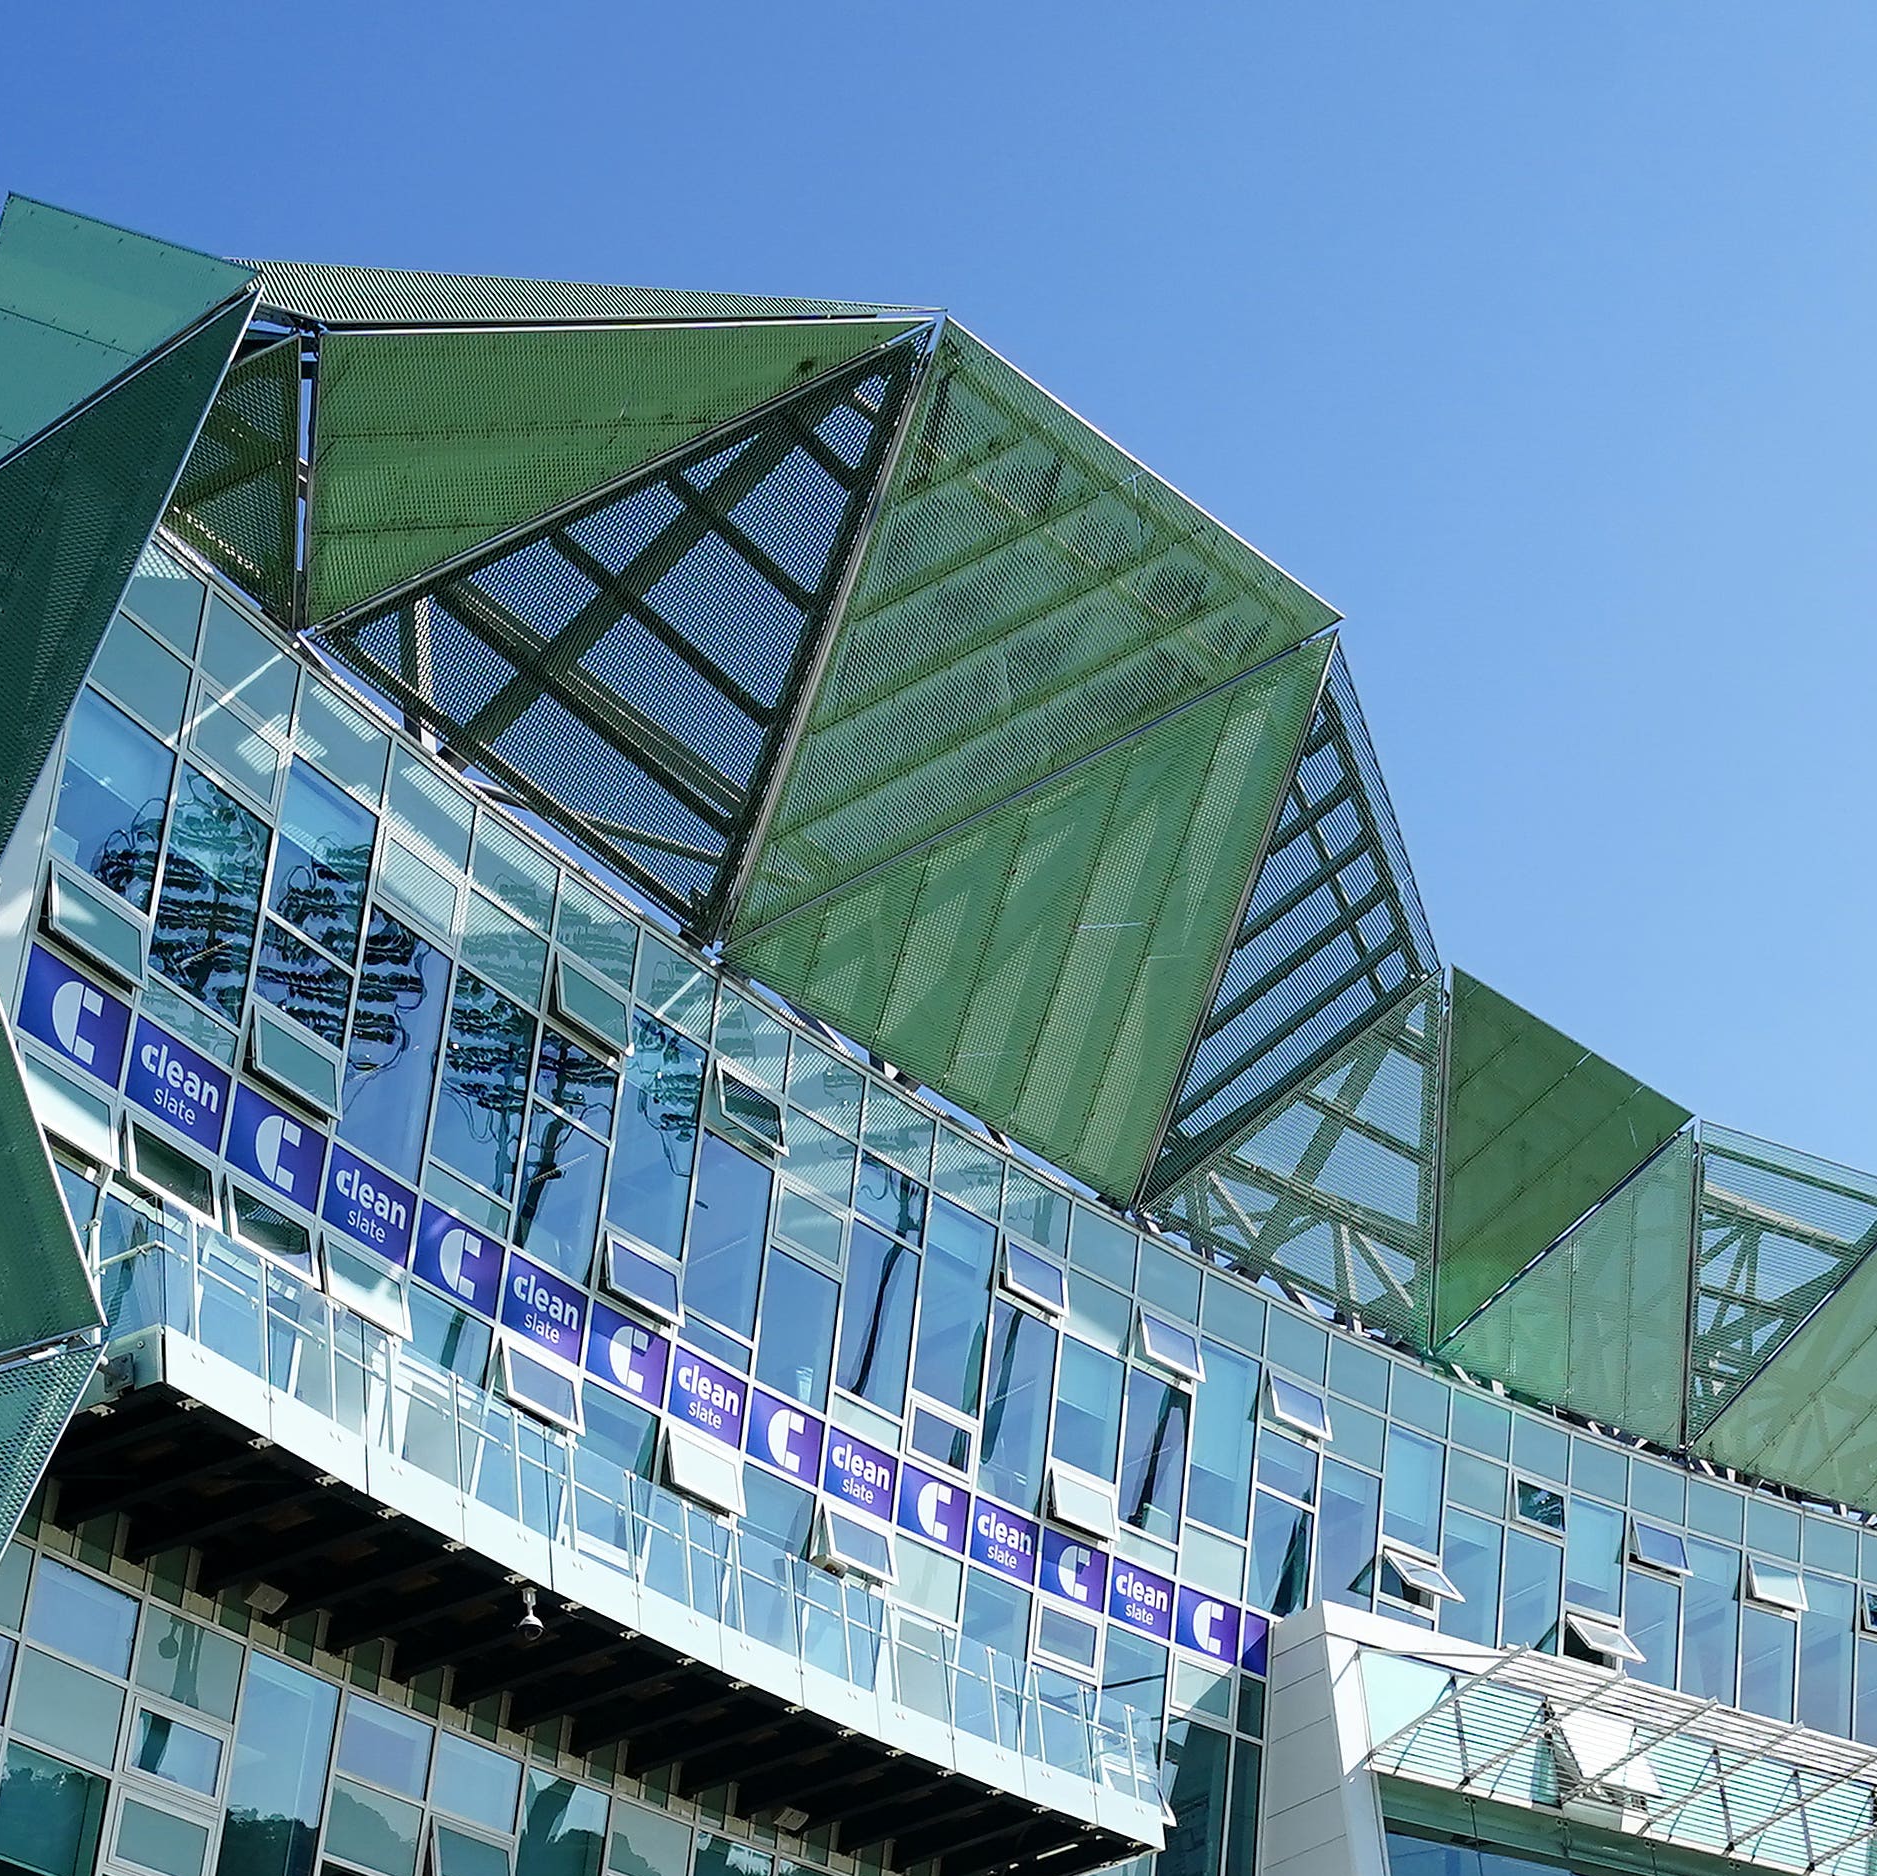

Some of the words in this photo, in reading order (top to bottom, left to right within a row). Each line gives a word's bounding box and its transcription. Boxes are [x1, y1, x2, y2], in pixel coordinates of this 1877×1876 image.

[141, 1043, 219, 1114] clean
[153, 1086, 196, 1126] slate
[335, 1168, 406, 1230] clean
[347, 1208, 386, 1243] slate
[513, 1274, 579, 1331] clean
[524, 1311, 560, 1345] slate
[677, 1364, 740, 1417] clean
[688, 1399, 722, 1430] slate
[831, 1443, 890, 1491] clean
[841, 1476, 874, 1505] slate
[977, 1511, 1032, 1556] clean
[987, 1544, 1018, 1569] slate
[1115, 1571, 1168, 1613] clean
[1124, 1602, 1154, 1626] slate
